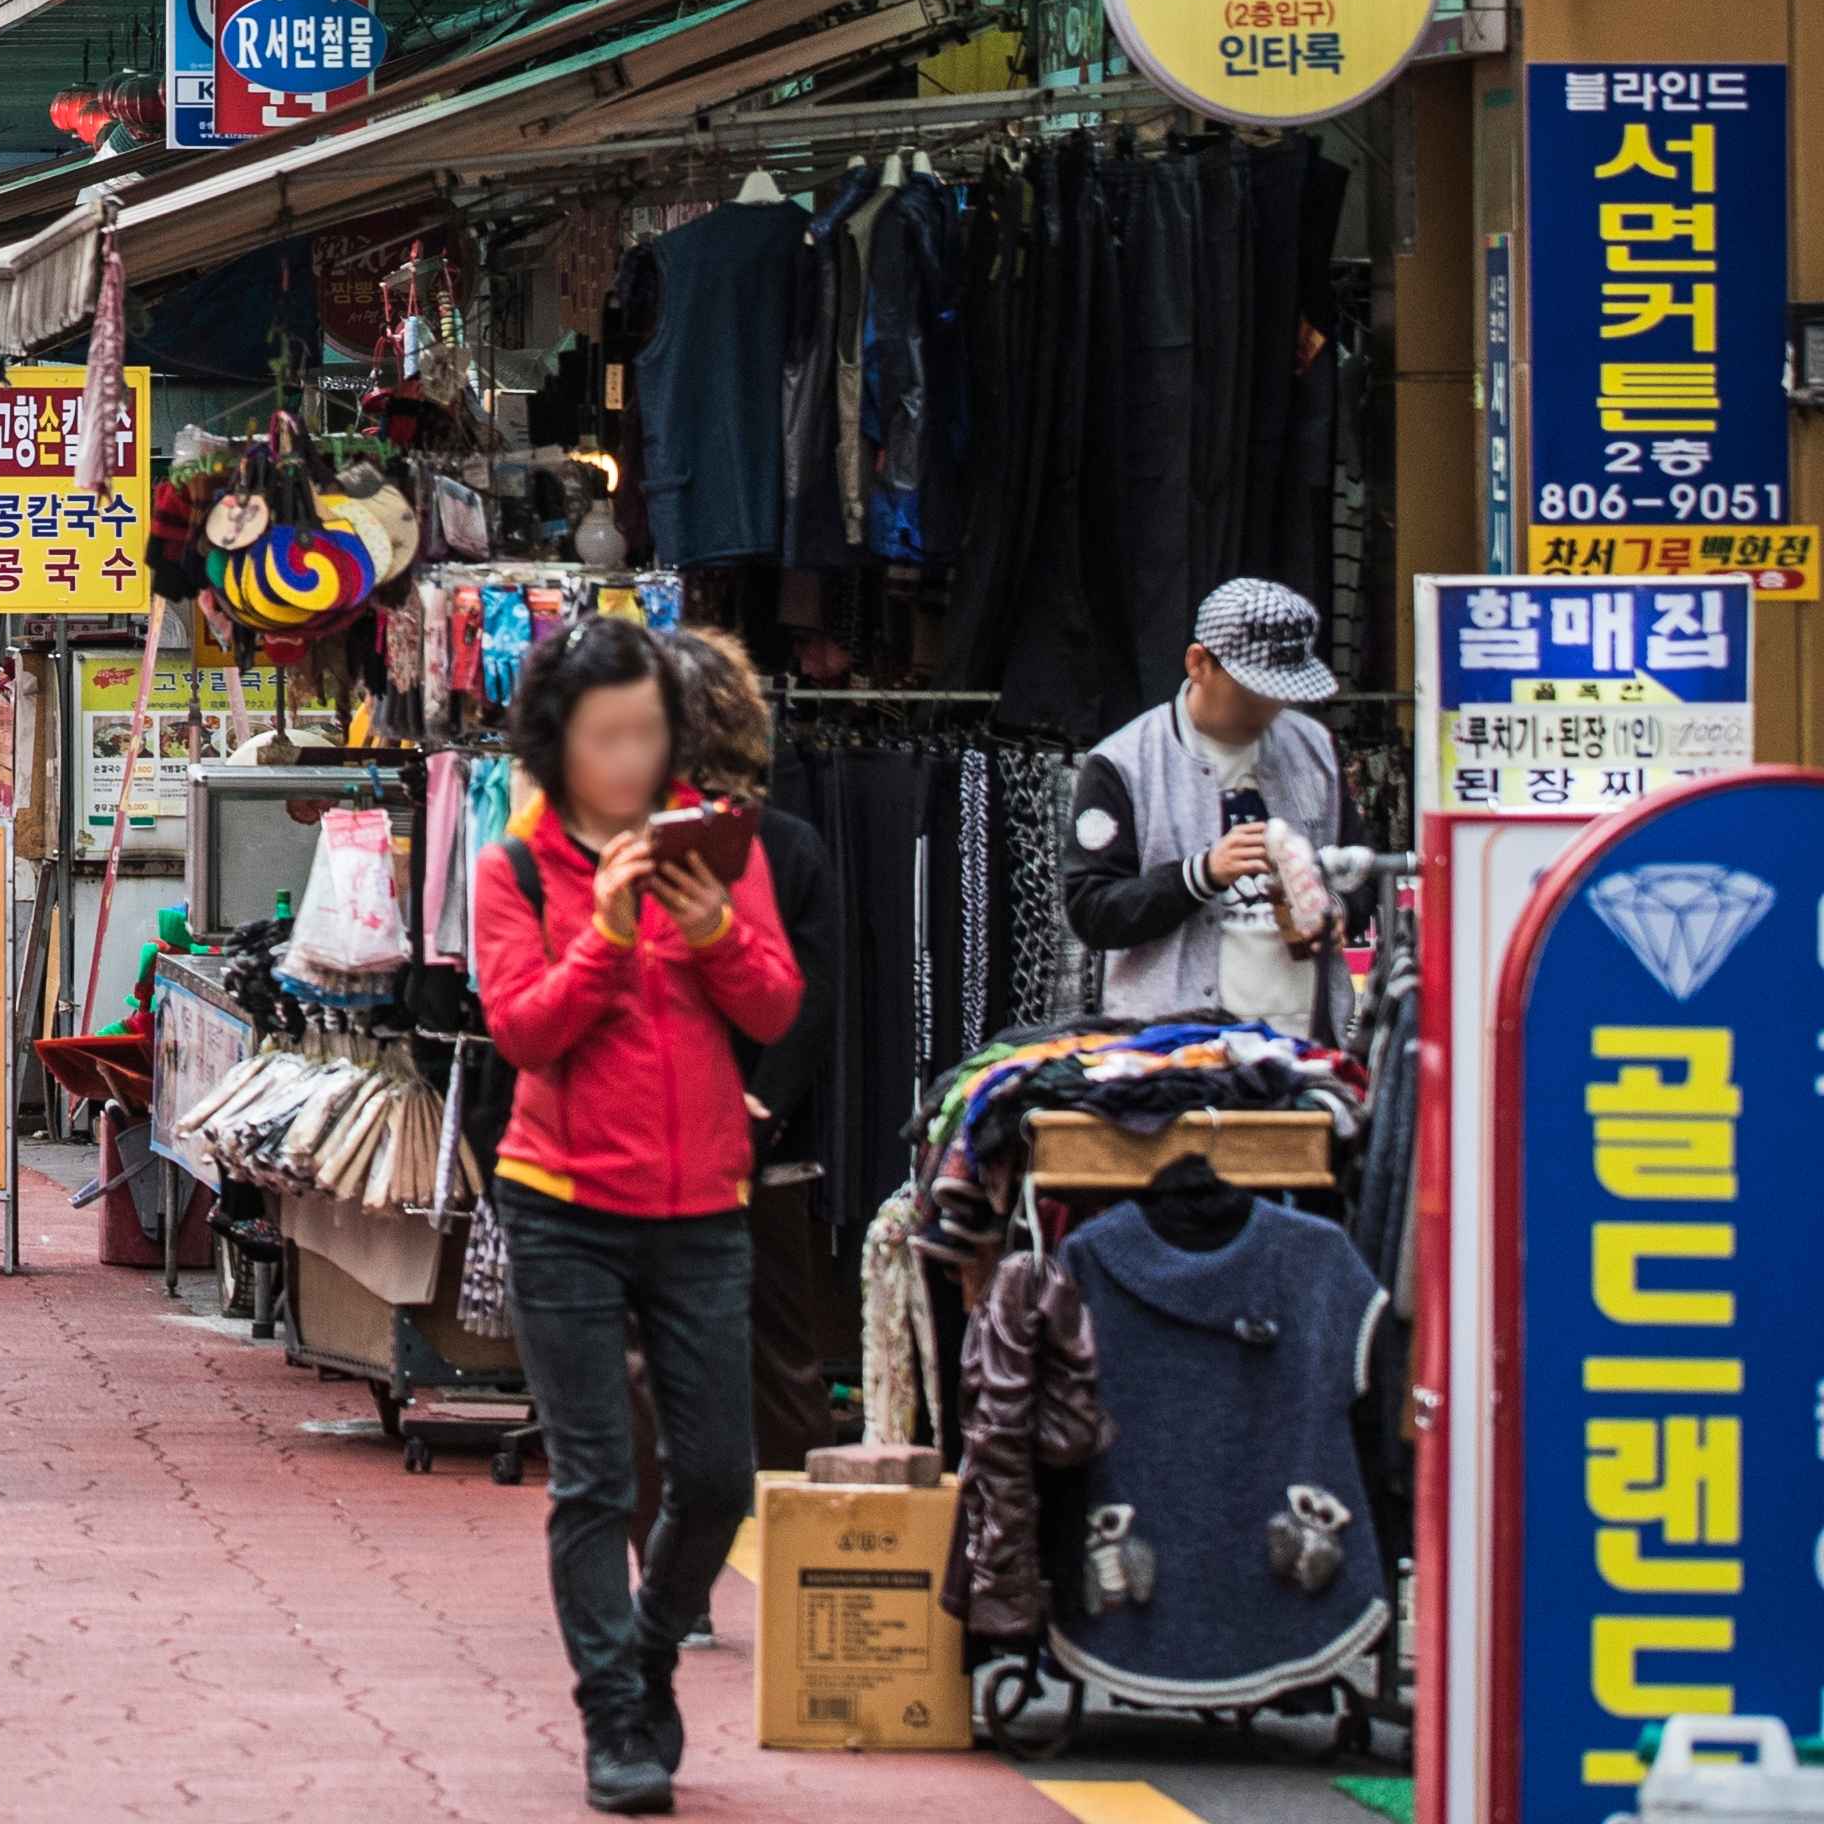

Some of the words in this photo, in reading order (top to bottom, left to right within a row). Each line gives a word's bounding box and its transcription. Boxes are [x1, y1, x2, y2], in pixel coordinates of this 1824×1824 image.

[1224, 0, 1334, 30] (2층입구)
[265, 15, 373, 69] 서면철물
[1219, 33, 1344, 77] 인타록
[1564, 71, 1749, 113] 블라인드
[1593, 123, 1721, 433] 서면커튼
[1604, 442, 1710, 475] 2층
[1541, 485, 1782, 521] 806-9051
[1459, 589, 1729, 673] 할매집
